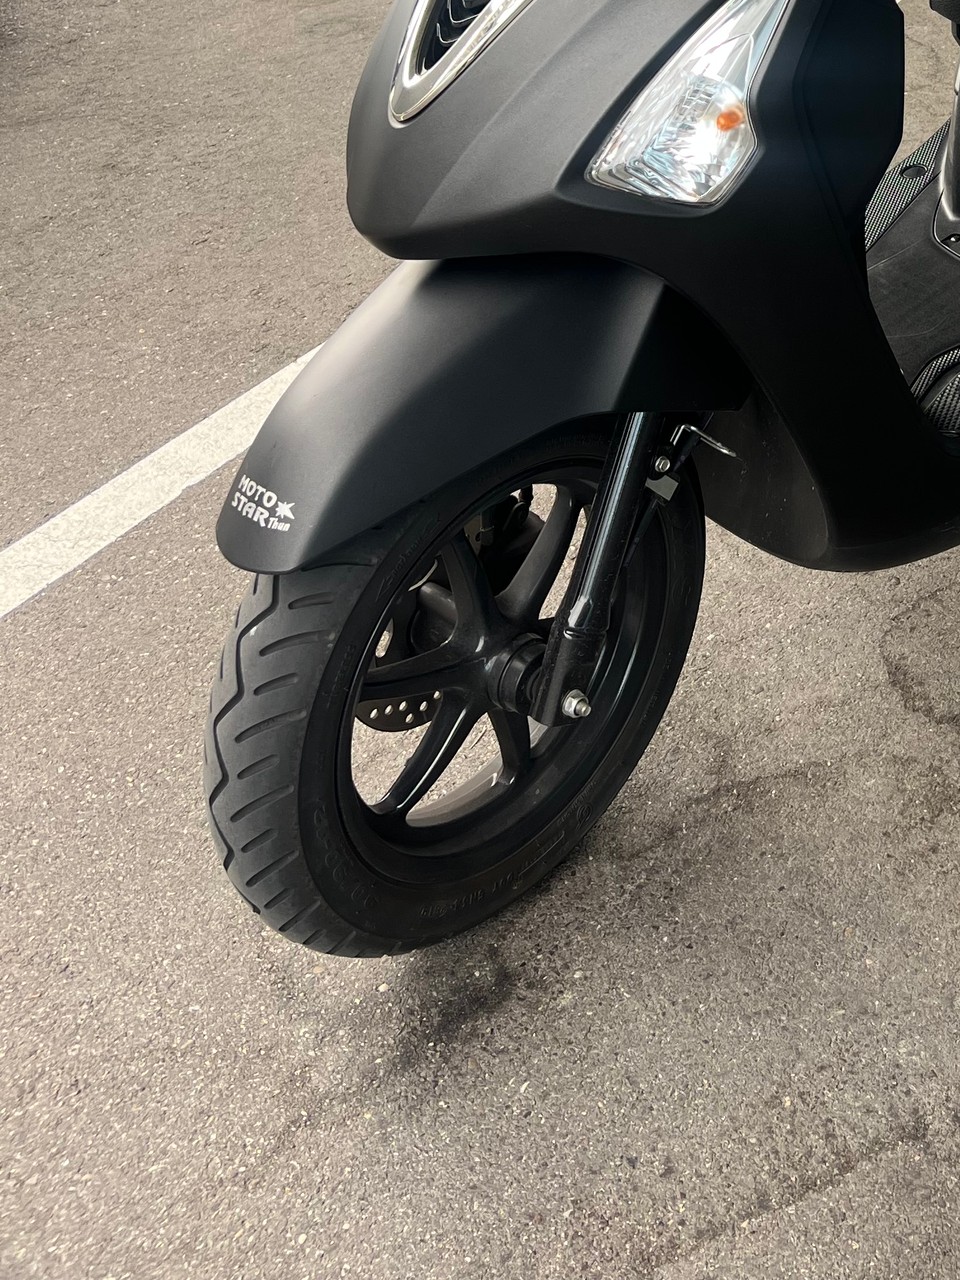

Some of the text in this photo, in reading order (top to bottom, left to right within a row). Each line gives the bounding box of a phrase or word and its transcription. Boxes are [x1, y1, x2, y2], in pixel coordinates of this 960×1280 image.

[238, 474, 278, 508] MOTO
[231, 491, 291, 532] STAR Thun
